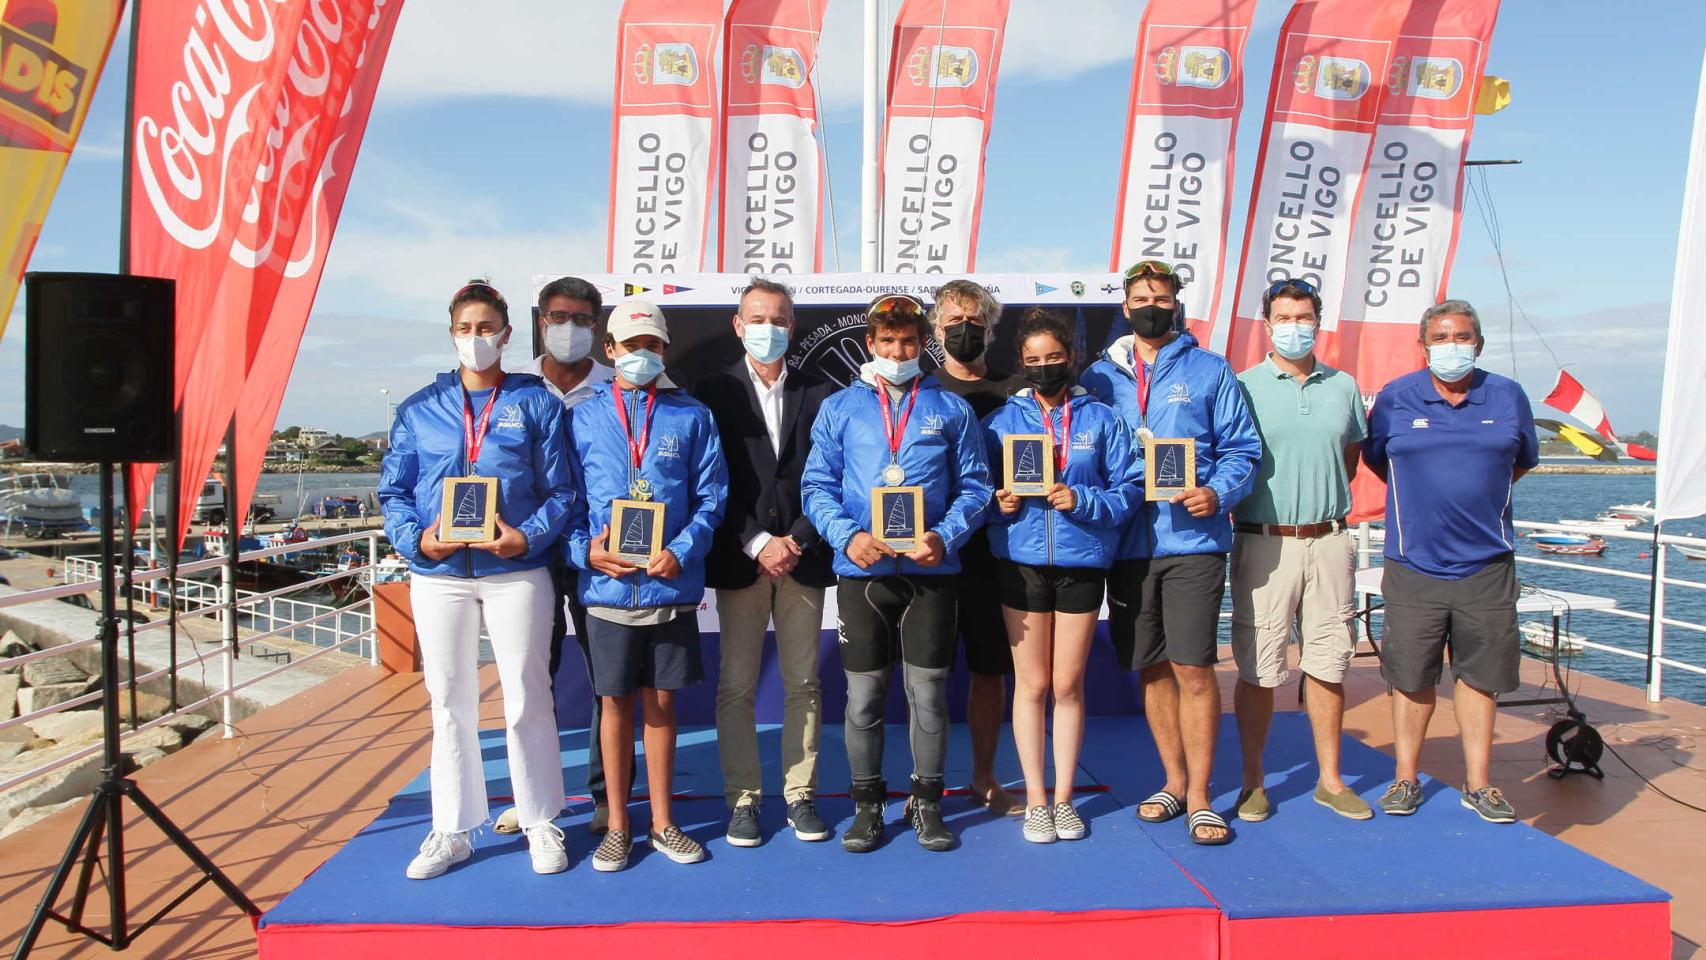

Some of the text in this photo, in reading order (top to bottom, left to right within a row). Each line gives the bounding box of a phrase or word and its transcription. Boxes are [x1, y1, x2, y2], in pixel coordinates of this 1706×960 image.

[0, 42, 79, 115] DIS
[137, 0, 288, 249] Coca-C
[633, 133, 661, 274] ONCELLO
[663, 153, 686, 231] VIGO
[743, 132, 768, 274] ONCELLO
[773, 151, 797, 229] VIGO
[895, 134, 932, 274] ONCELLO
[930, 154, 958, 231] VIGO
[1141, 132, 1177, 257] NCELLO
[1173, 152, 1206, 284] DE VIGO
[1267, 141, 1314, 284] ONCELLO
[1307, 166, 1340, 239] VIGO
[1364, 141, 1408, 307] CONCELLO
[1398, 161, 1438, 287] DE VIGO
[800, 323, 833, 351] PESADA
[837, 313, 868, 328] MONO
[805, 285, 909, 294] CORTEGADA-OURENSE
